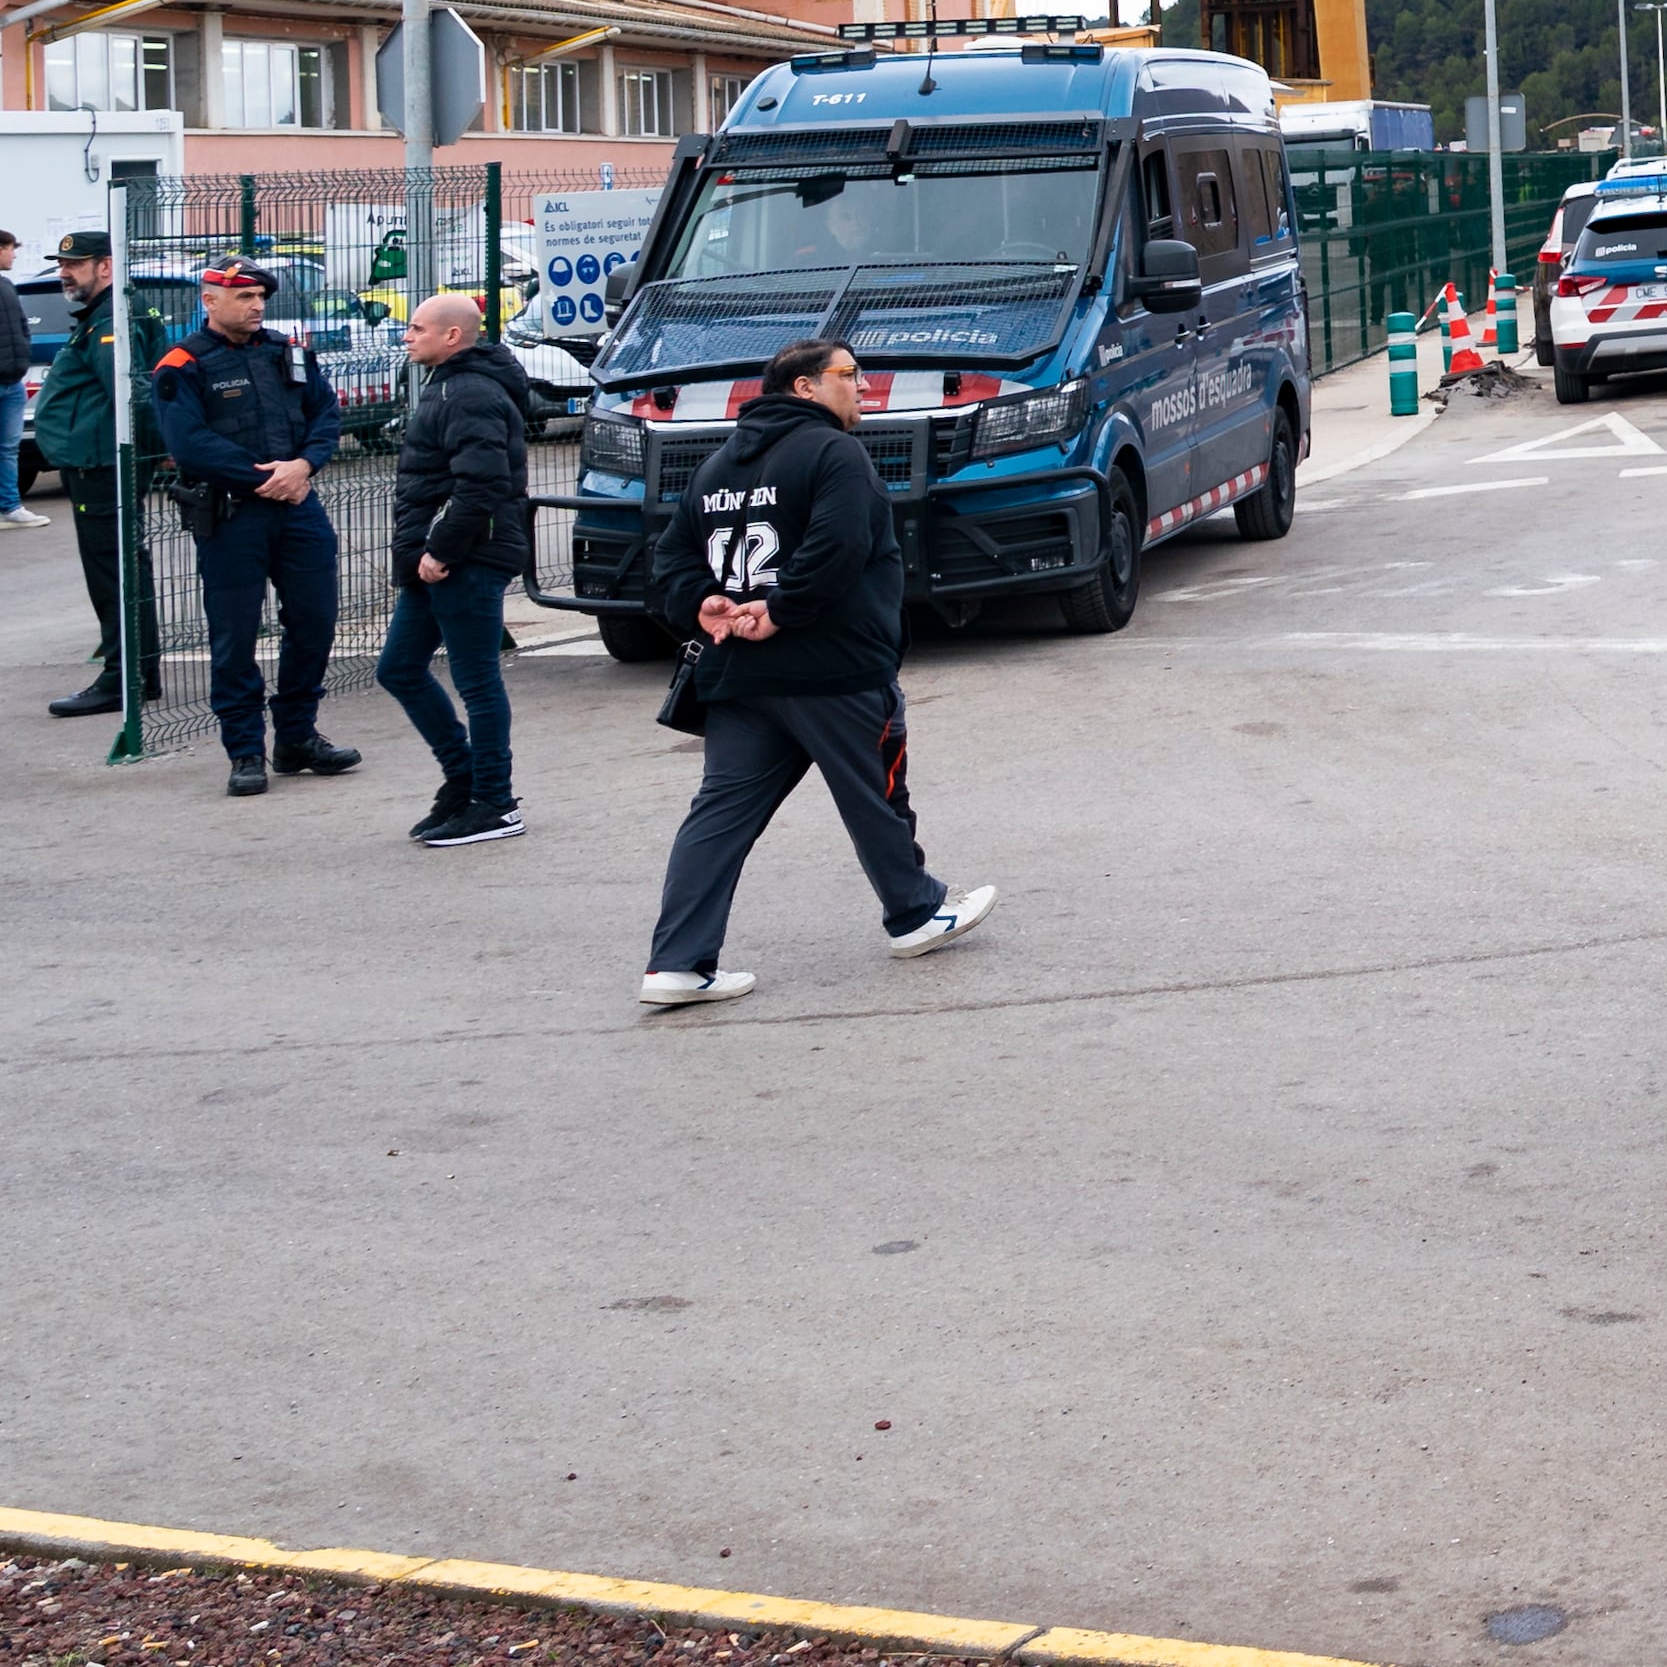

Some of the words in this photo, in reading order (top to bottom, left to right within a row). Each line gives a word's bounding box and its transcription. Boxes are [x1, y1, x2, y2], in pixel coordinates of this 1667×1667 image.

[812, 92, 867, 106] T-611
[545, 220, 556, 233] És
[559, 218, 604, 233] obligatori
[607, 217, 635, 230] seguir
[546, 237, 581, 247] normes
[584, 234, 596, 245] de
[599, 231, 642, 245] seguretat
[1605, 243, 1638, 255] policia
[1636, 286, 1657, 299] CME
[886, 329, 1000, 346] policia
[212, 378, 251, 391] POLICIA
[1151, 384, 1196, 432] mossos
[1198, 359, 1252, 410] d'esquadra
[703, 486, 777, 513] MÜNHEN
